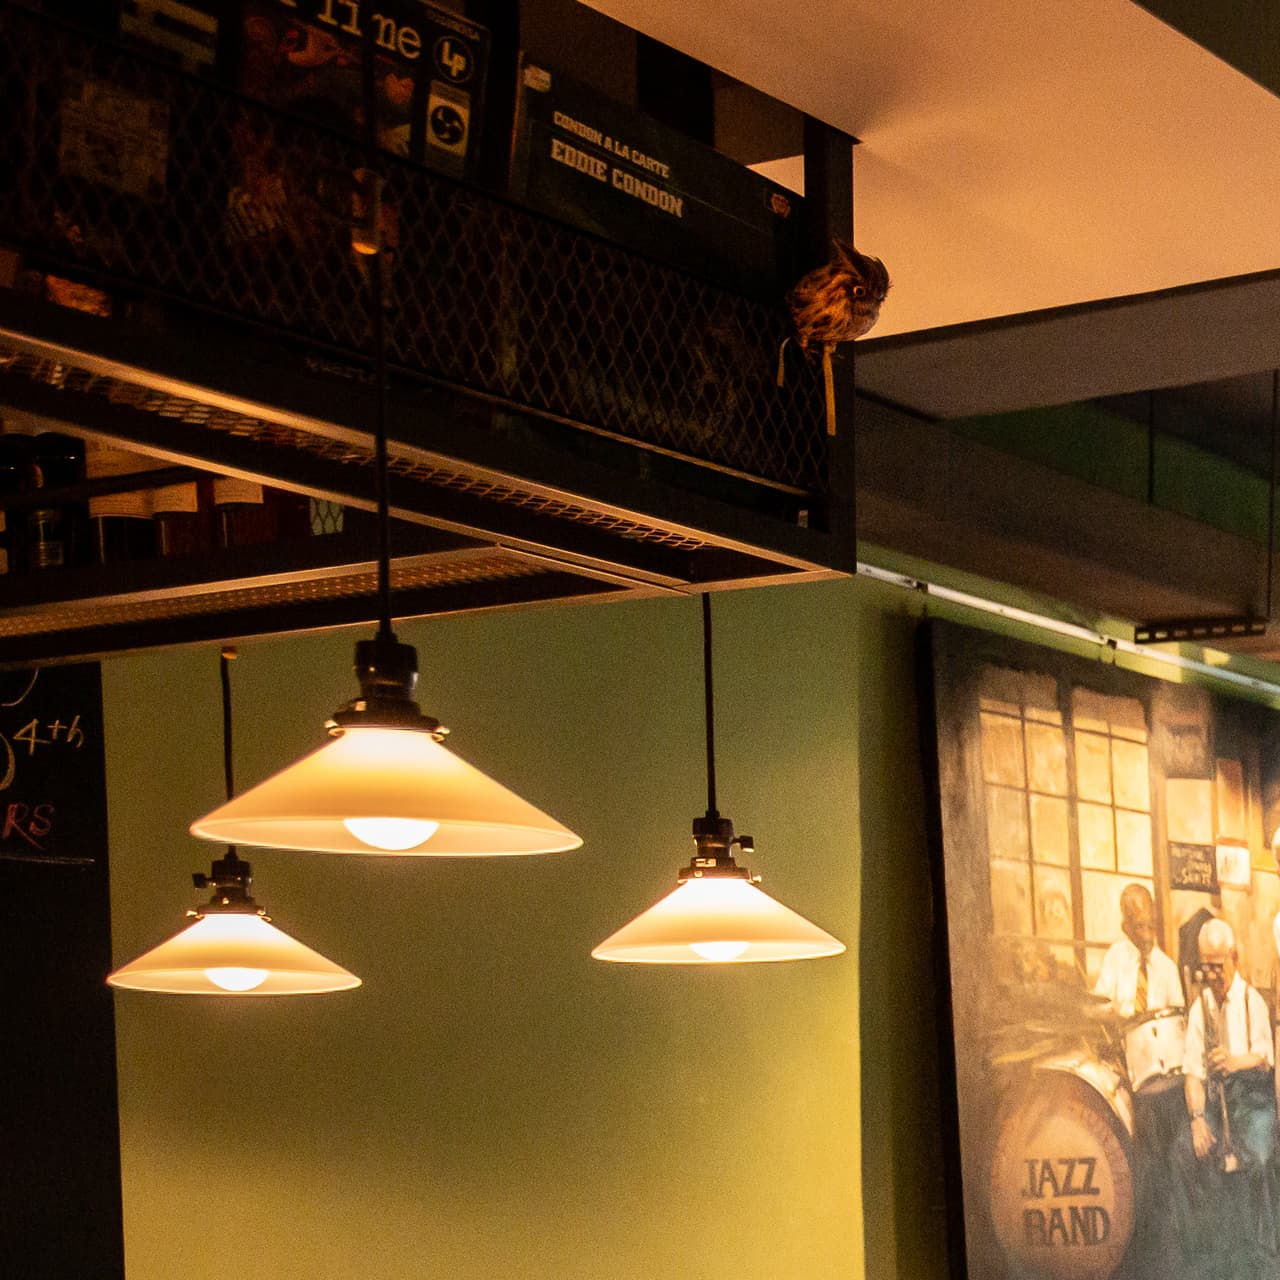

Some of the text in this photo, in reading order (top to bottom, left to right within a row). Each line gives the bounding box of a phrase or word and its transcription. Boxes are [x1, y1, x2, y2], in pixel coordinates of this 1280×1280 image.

[550, 138, 683, 219] EDDIE CONDON
[631, 149, 671, 179] CARTE
[1021, 1156, 1100, 1198] JAZZ
[1022, 1204, 1111, 1247] BAND
